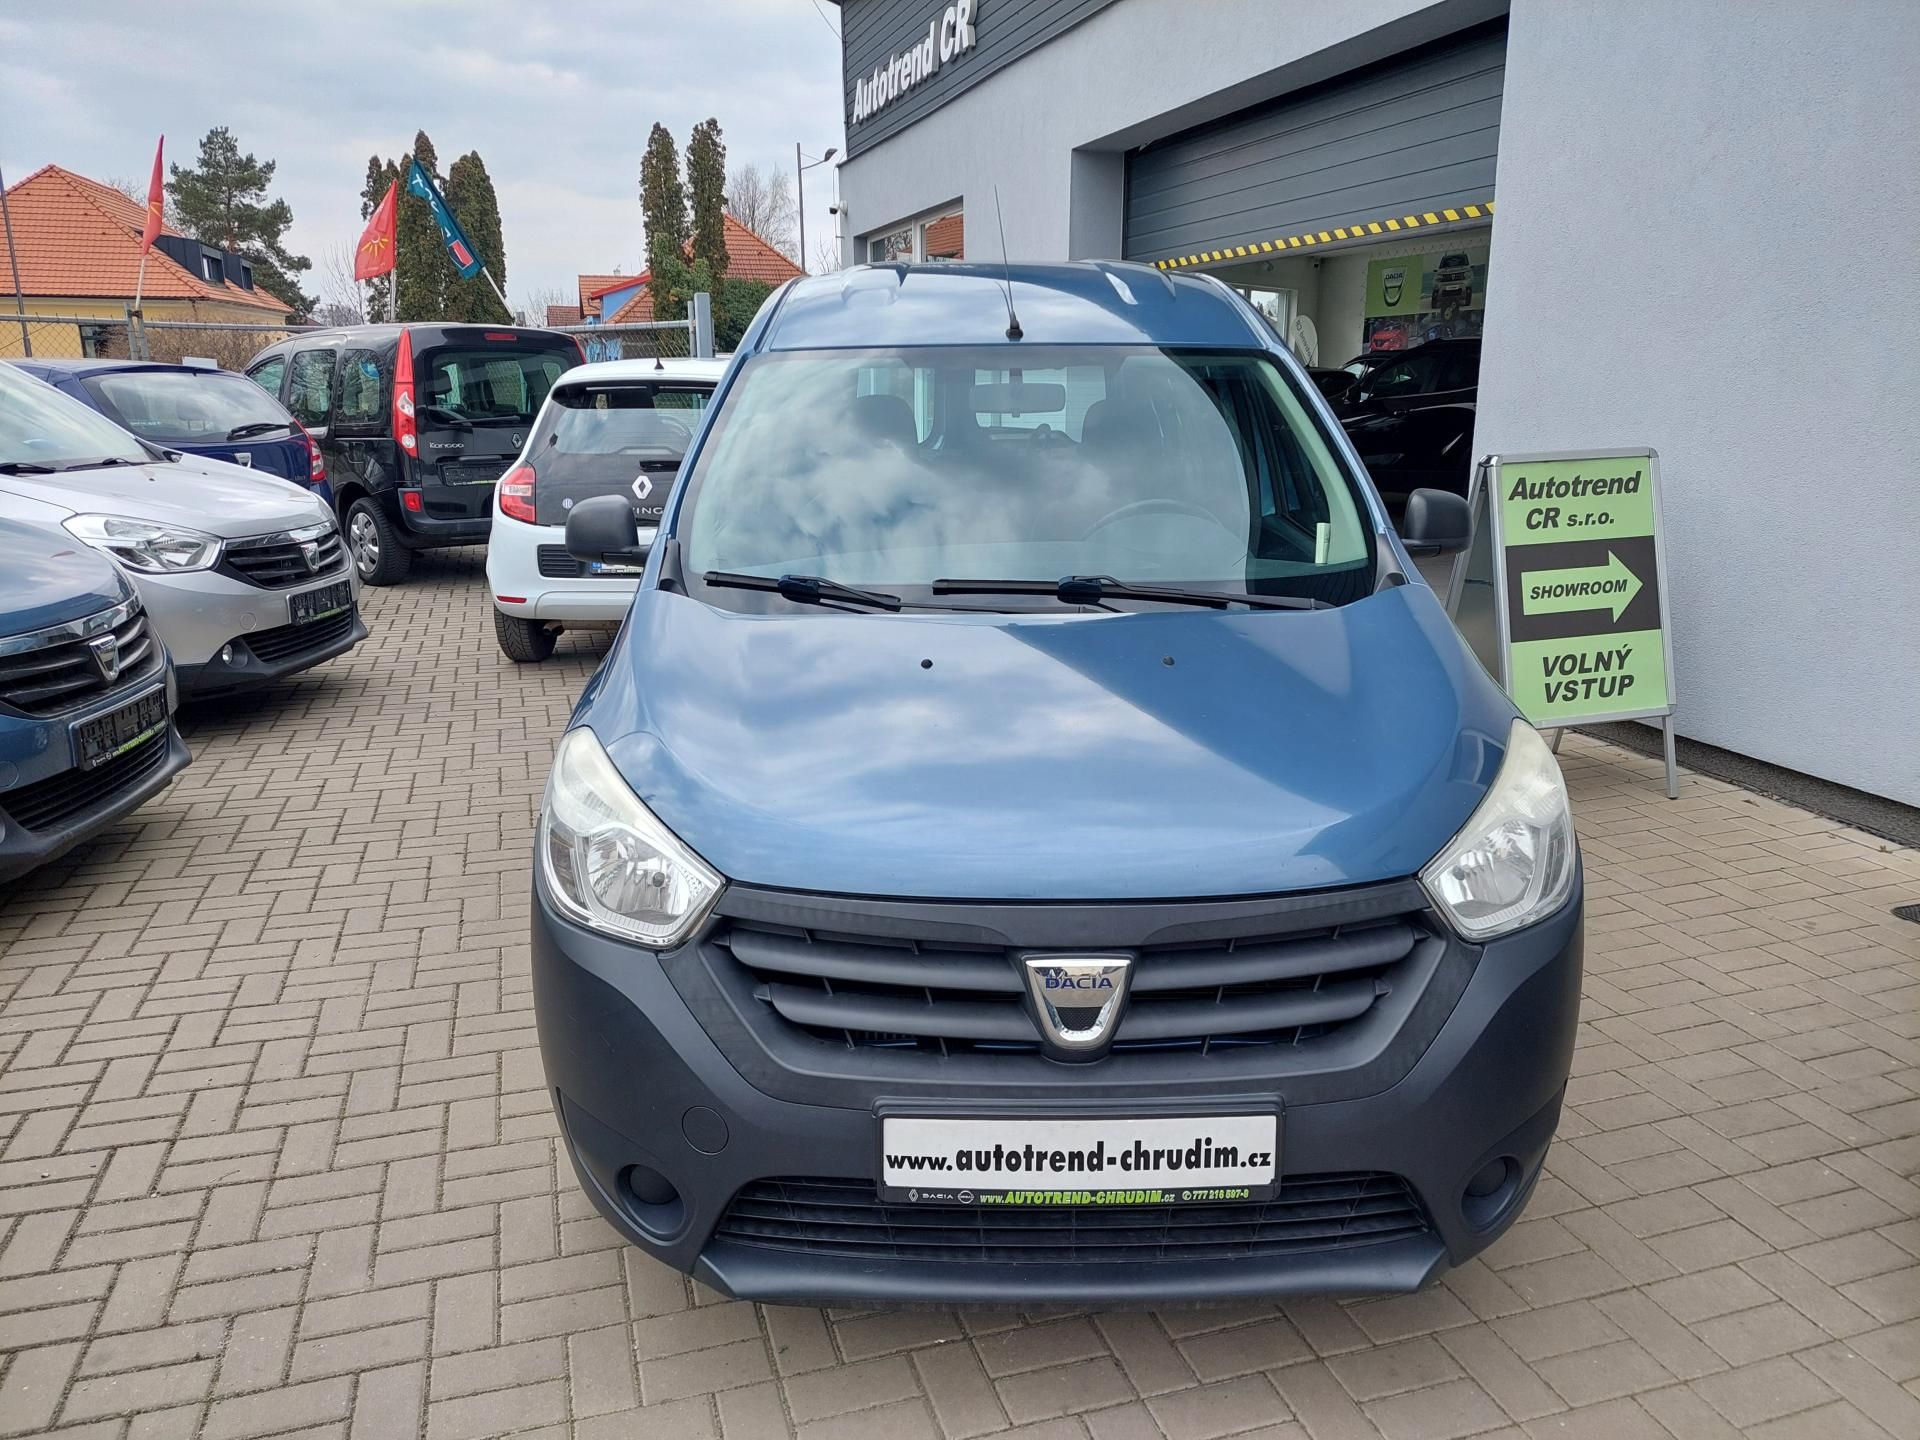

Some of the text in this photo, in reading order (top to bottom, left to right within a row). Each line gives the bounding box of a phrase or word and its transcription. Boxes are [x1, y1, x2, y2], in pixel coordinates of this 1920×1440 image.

[852, 0, 974, 124] Autotrend CR
[1508, 470, 1642, 501] Autotrend
[1526, 507, 1615, 530] CR s.r.o.
[1530, 579, 1628, 600] SHOWROOM
[1542, 643, 1632, 678] VOLNÝ
[1544, 674, 1634, 704] VSTUP
[1045, 977, 1113, 989] DACIA
[886, 1137, 1272, 1172] www.autotrend-chrudim.cz
[980, 1190, 1175, 1205] www.AUTOTREND-CHRUDIM.cz
